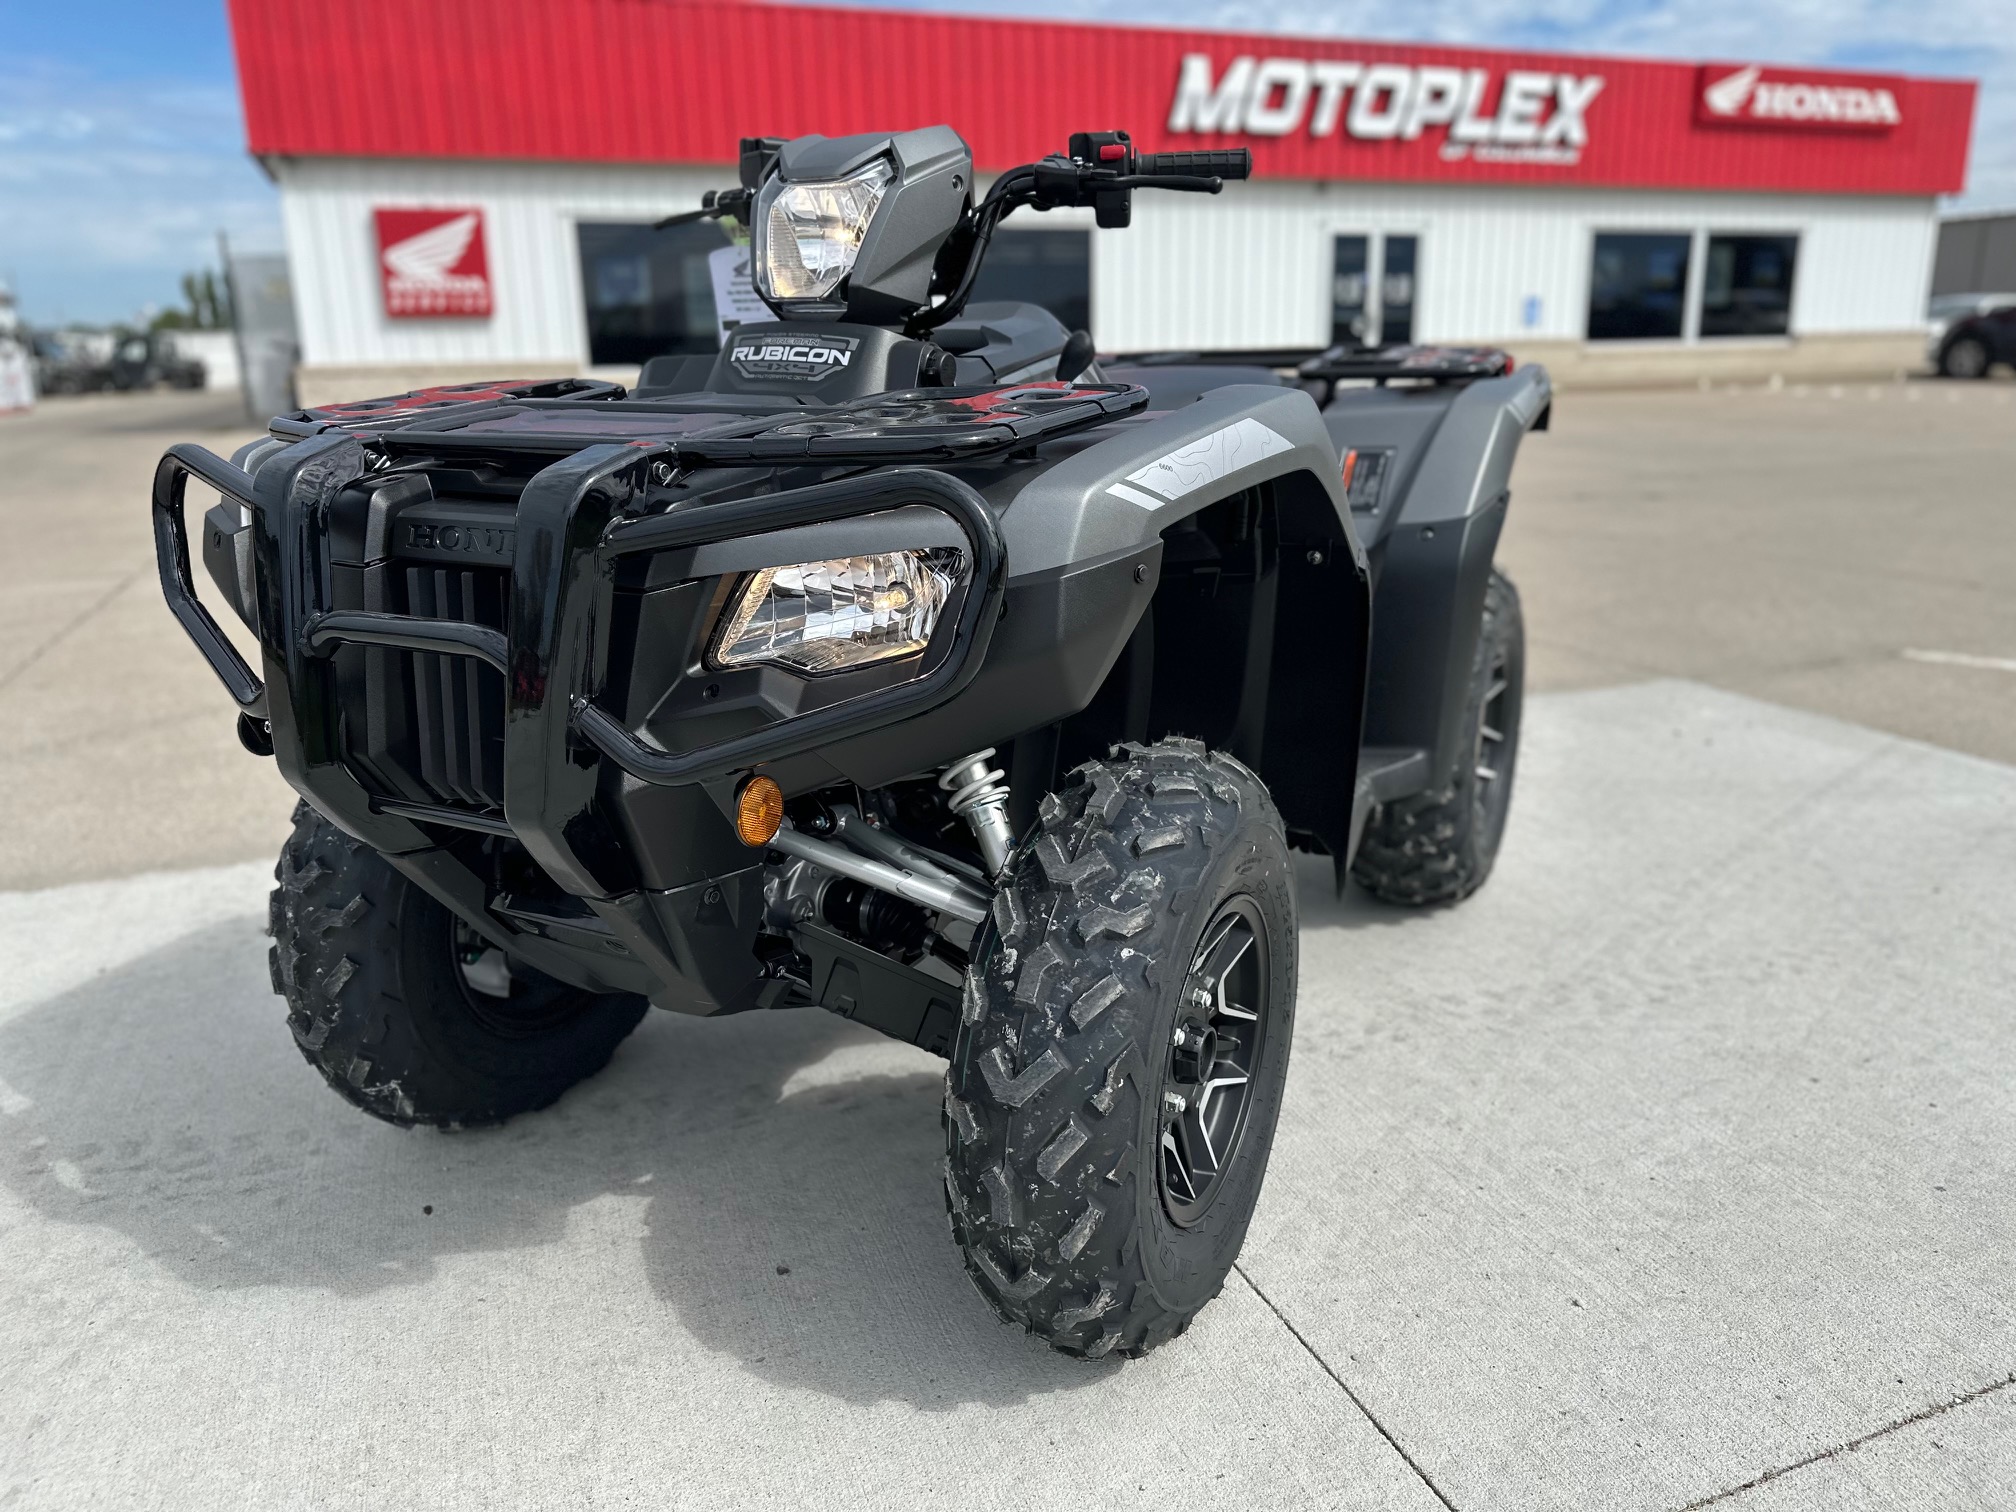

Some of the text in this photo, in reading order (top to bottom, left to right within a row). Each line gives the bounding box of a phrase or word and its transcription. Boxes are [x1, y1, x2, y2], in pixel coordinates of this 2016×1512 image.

[1168, 53, 1604, 147] MOTOPLEX
[1752, 82, 1902, 125] HONDA
[731, 346, 851, 366] RUBICON
